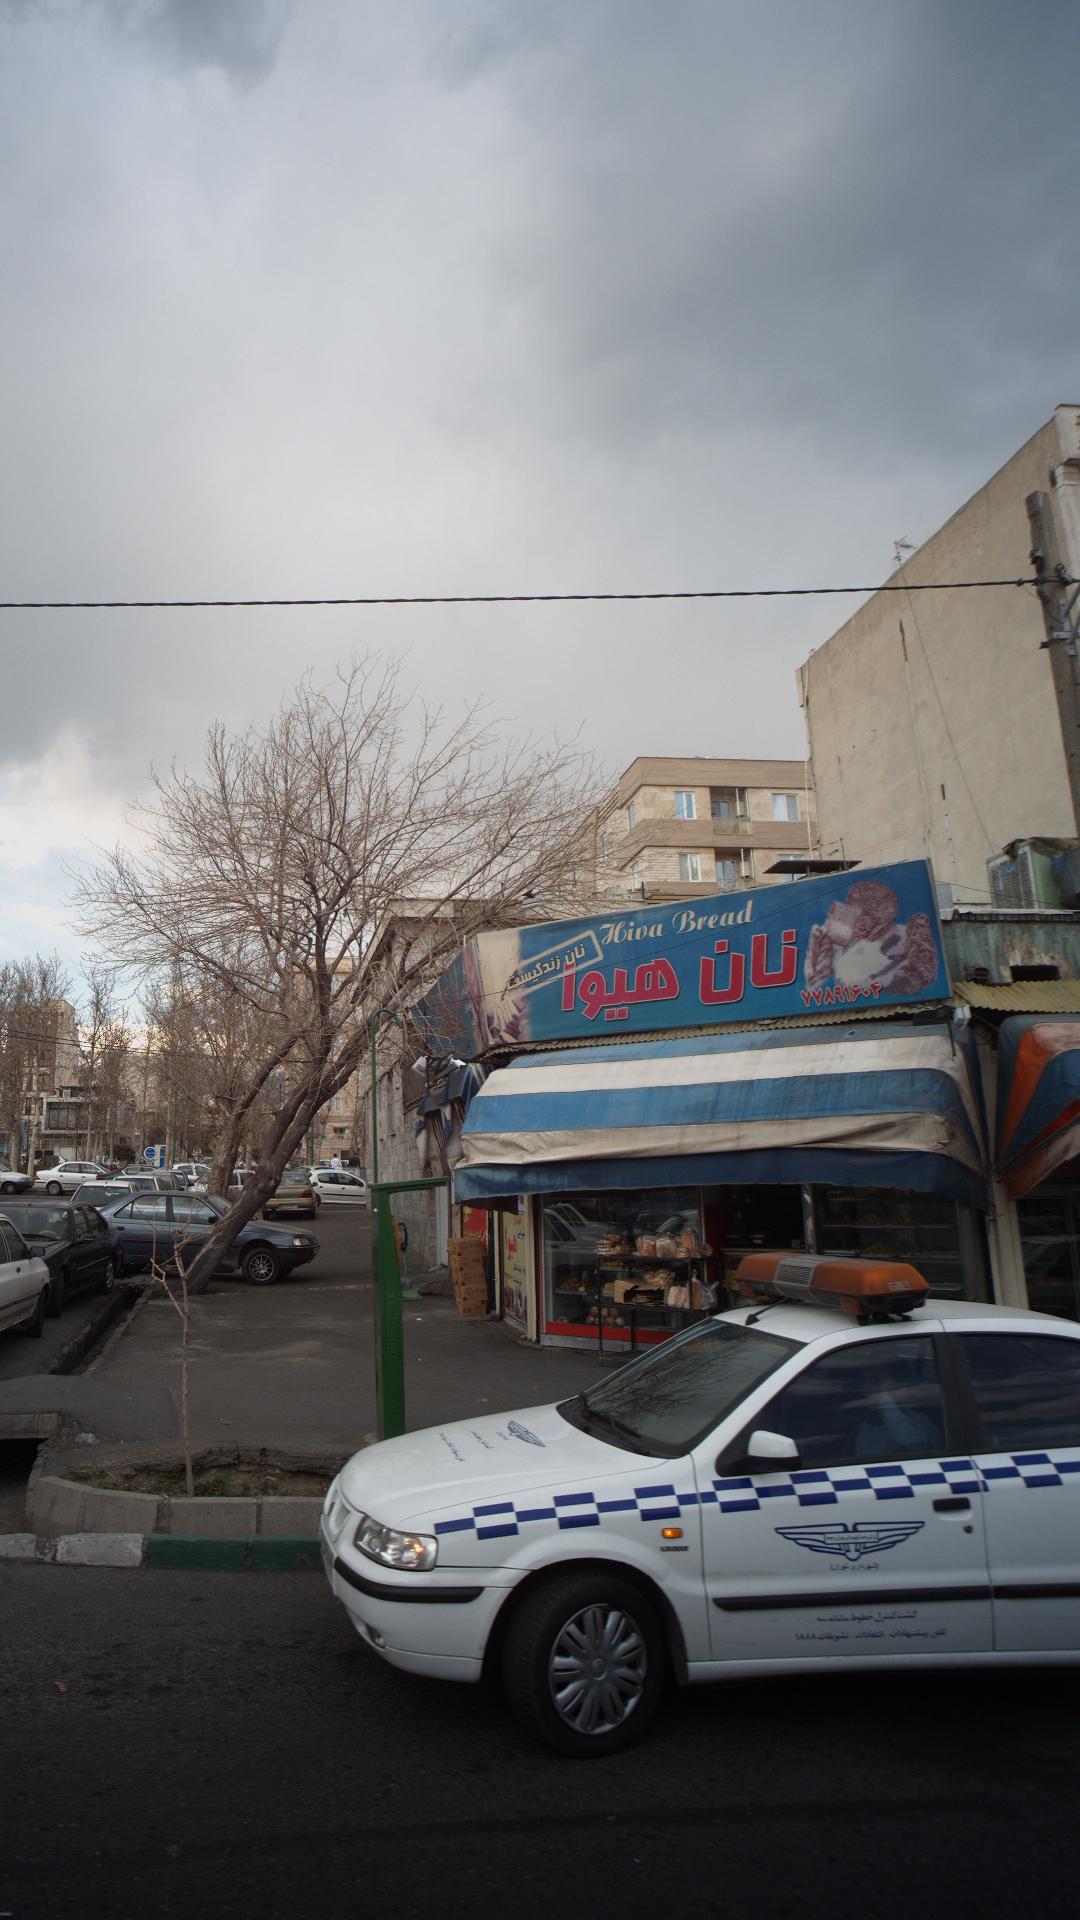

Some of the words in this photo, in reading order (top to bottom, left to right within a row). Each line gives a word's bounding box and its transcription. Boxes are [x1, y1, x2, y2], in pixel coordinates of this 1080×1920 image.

[599, 920, 667, 945] Hiva
[672, 899, 755, 934] Bread
[564, 942, 587, 965] نان
[700, 929, 798, 1005] نان
[561, 957, 680, 1021] هیوا
